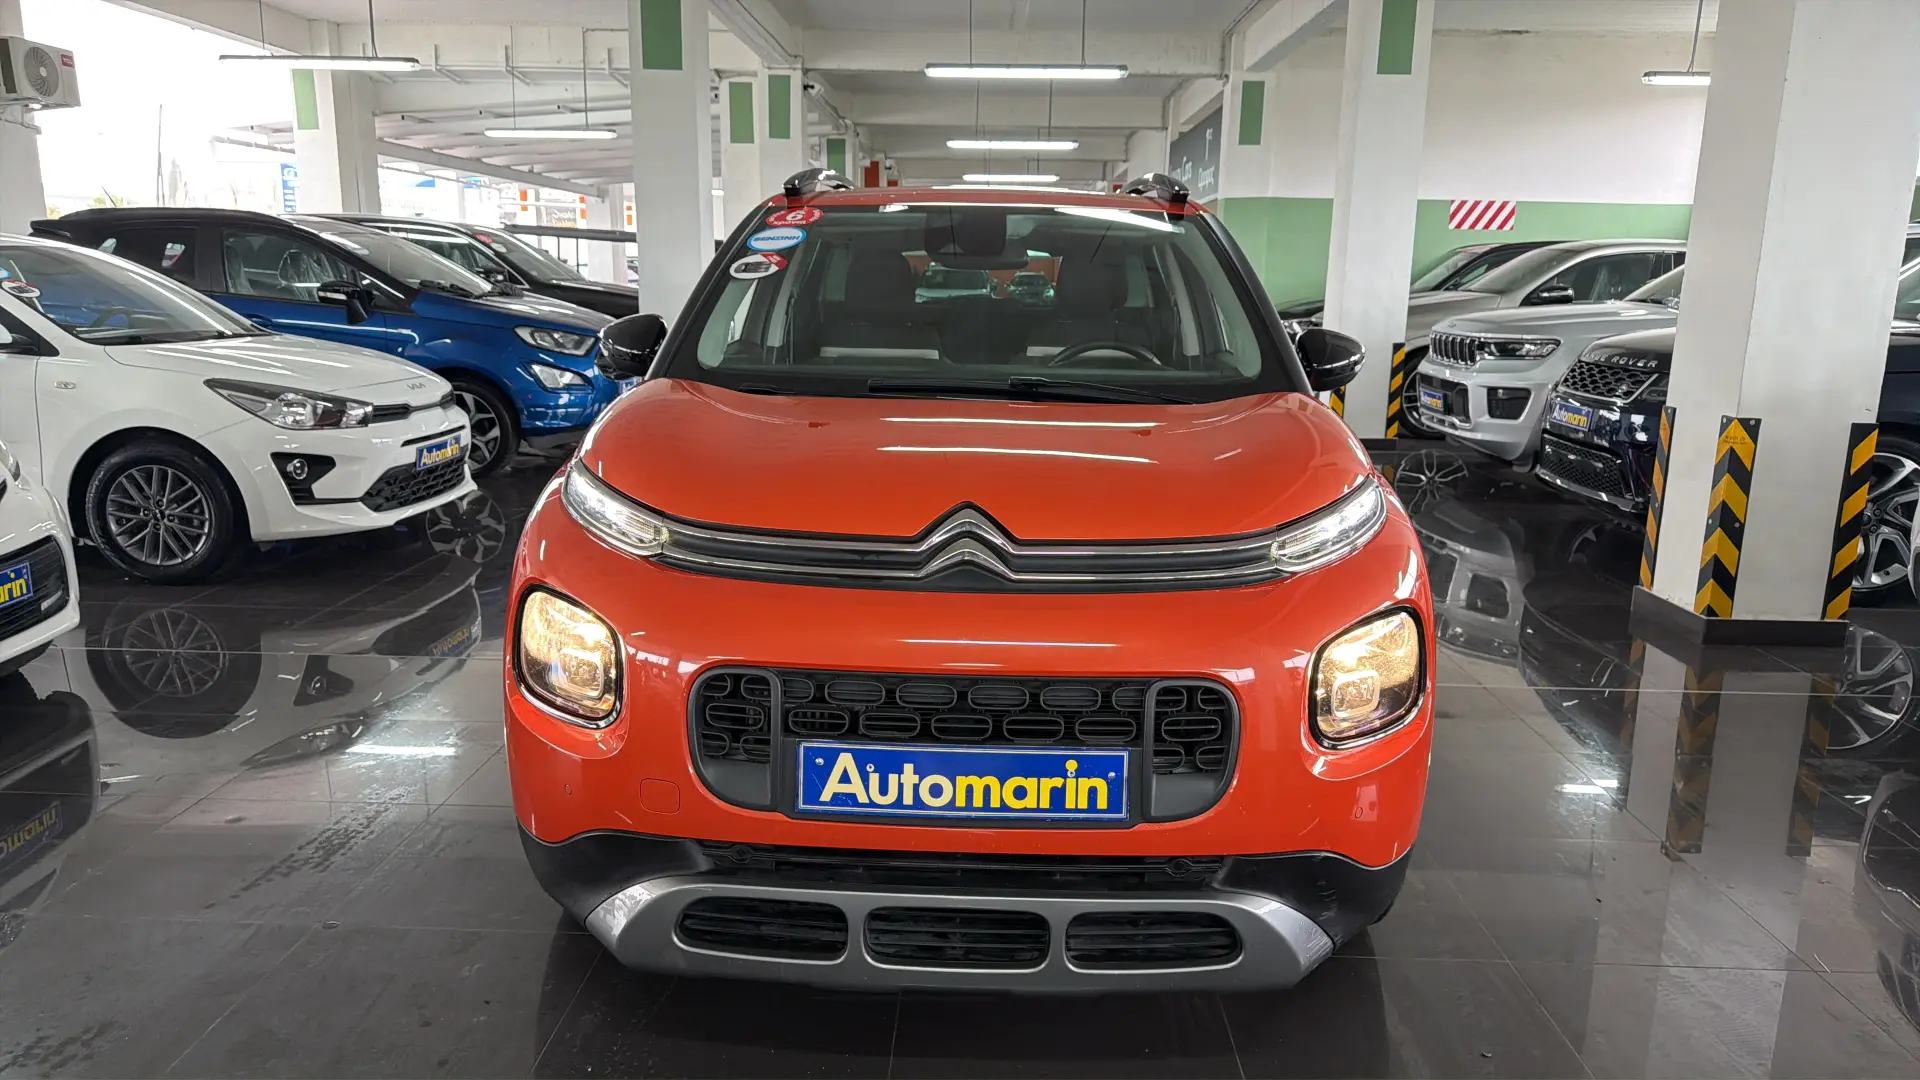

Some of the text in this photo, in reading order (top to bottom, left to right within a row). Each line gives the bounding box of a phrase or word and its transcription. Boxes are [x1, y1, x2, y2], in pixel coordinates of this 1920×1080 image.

[785, 210, 806, 221] 6
[1611, 356, 1658, 368] ROVER
[1552, 404, 1588, 427] Automarin
[420, 441, 459, 466] Automarin
[819, 752, 1109, 810] Automarin
